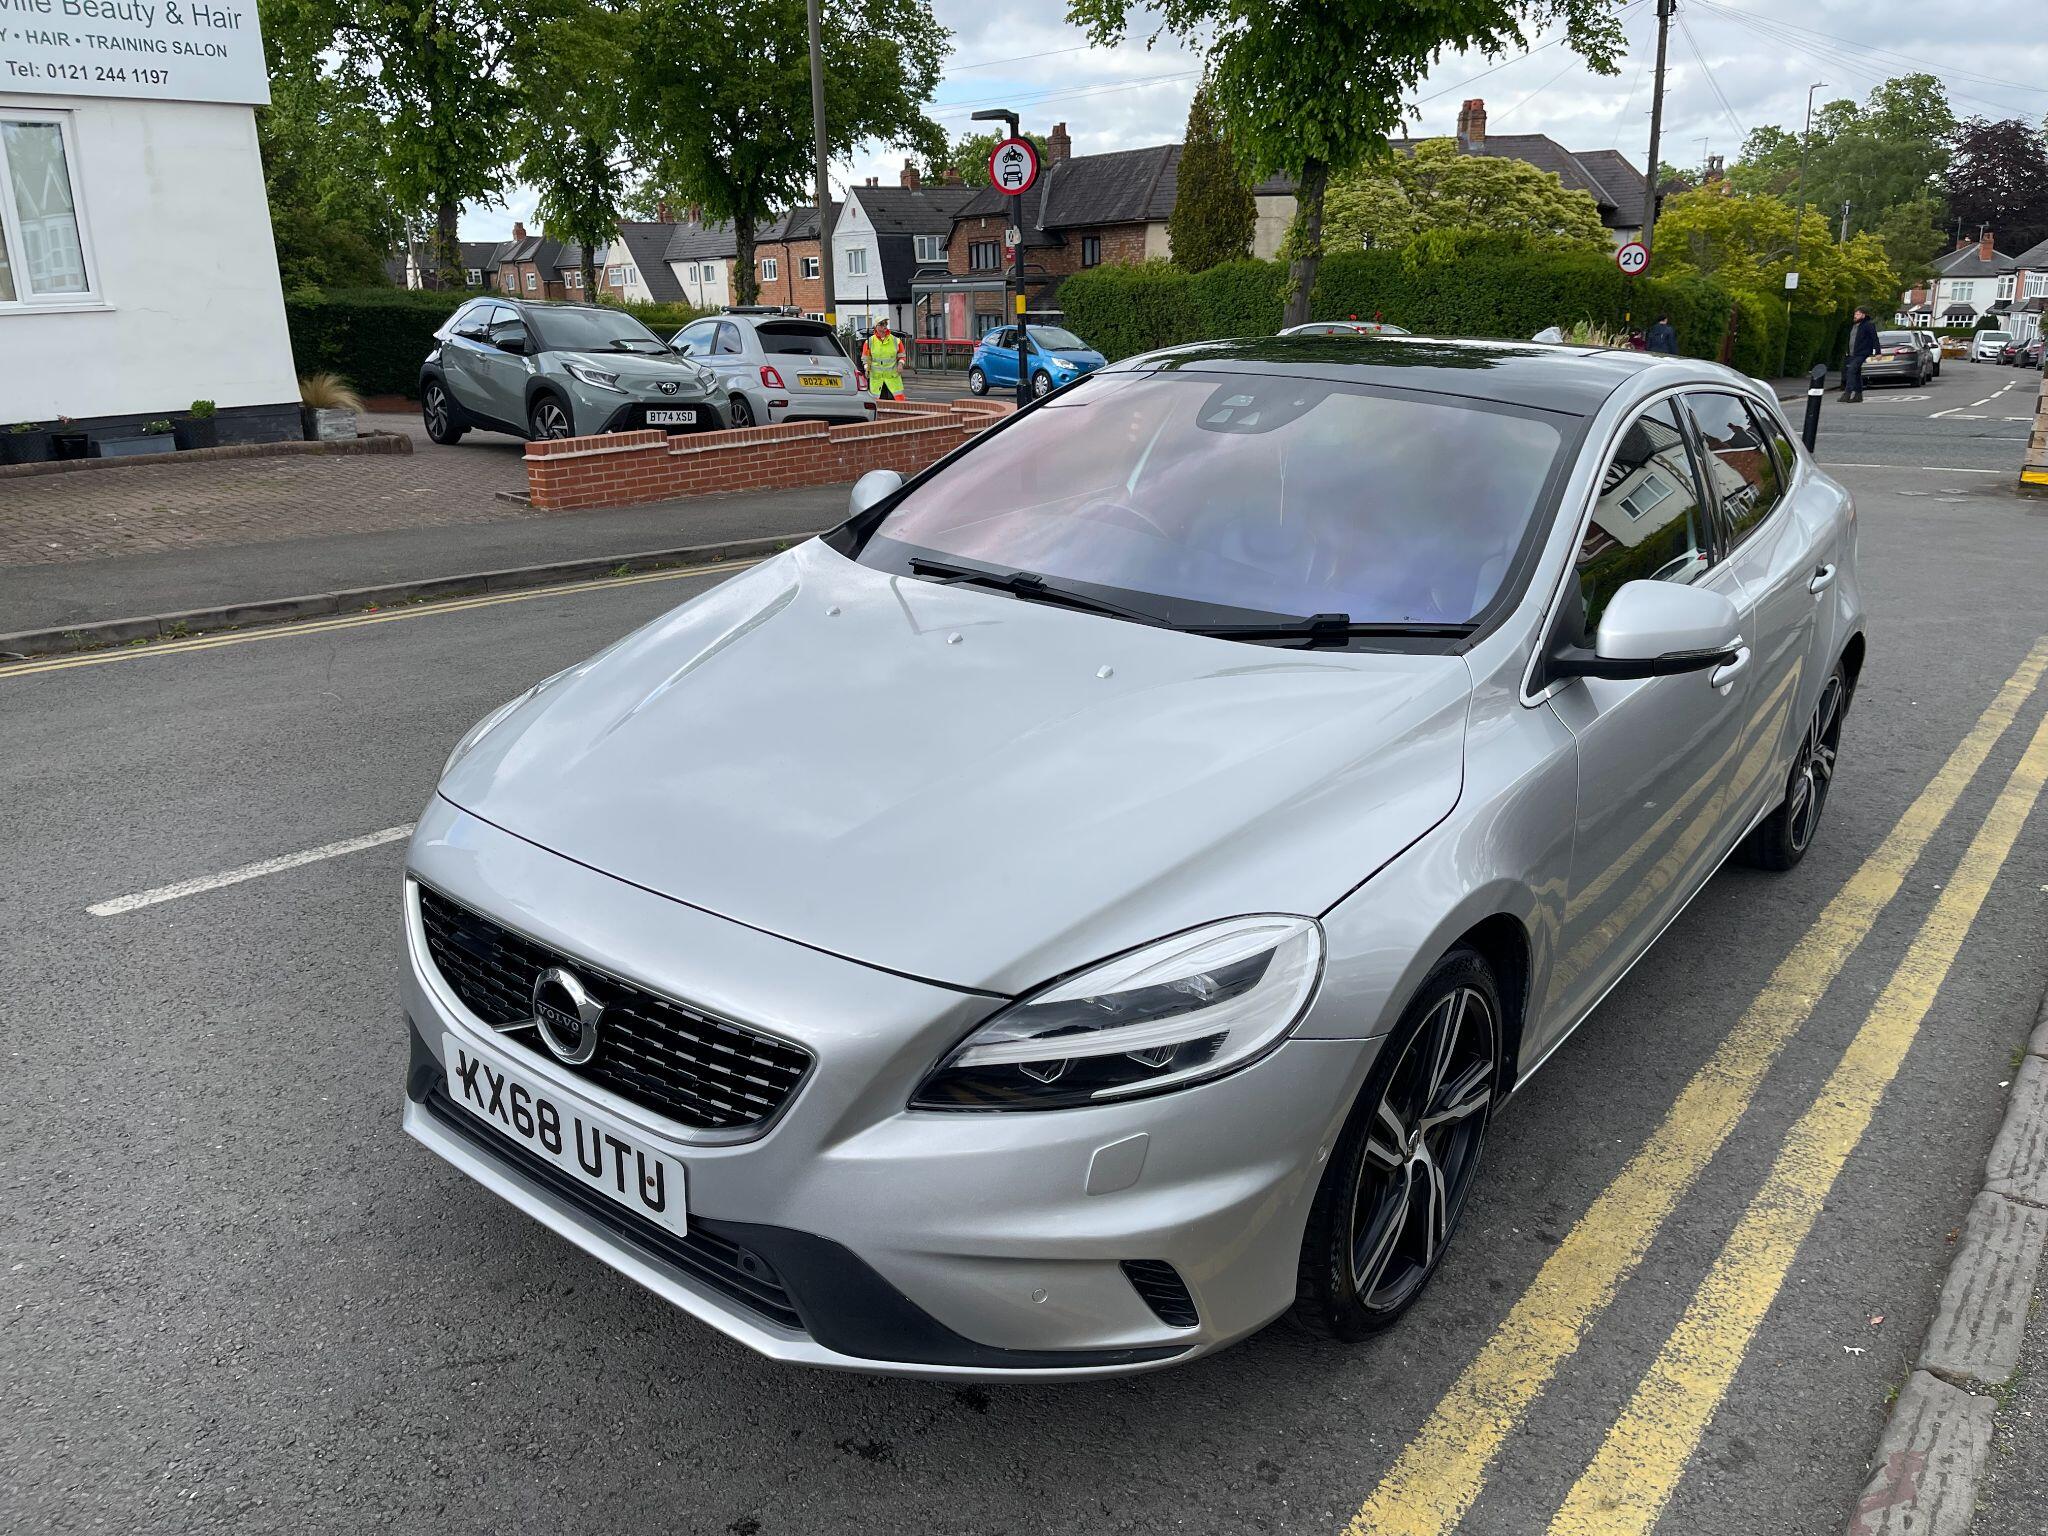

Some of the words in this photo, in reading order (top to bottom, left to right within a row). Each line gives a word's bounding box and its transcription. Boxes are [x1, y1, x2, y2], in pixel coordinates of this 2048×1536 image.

[63, 0, 155, 28] Beauty
[165, 1, 184, 25] &
[191, 3, 242, 30] Hair
[25, 29, 71, 47] HAIR
[85, 34, 168, 54] TRAINING
[172, 41, 228, 58] SALON
[5, 60, 41, 78] Tel:
[47, 63, 88, 80] 0121
[95, 66, 126, 82] 244
[132, 68, 169, 85] 1197
[1622, 252, 1644, 265] 20
[650, 412, 673, 422] BT74
[676, 412, 693, 422] XSD
[536, 1003, 580, 1031] VOLVO
[458, 1049, 563, 1155] KX68
[574, 1117, 666, 1213] UTU
